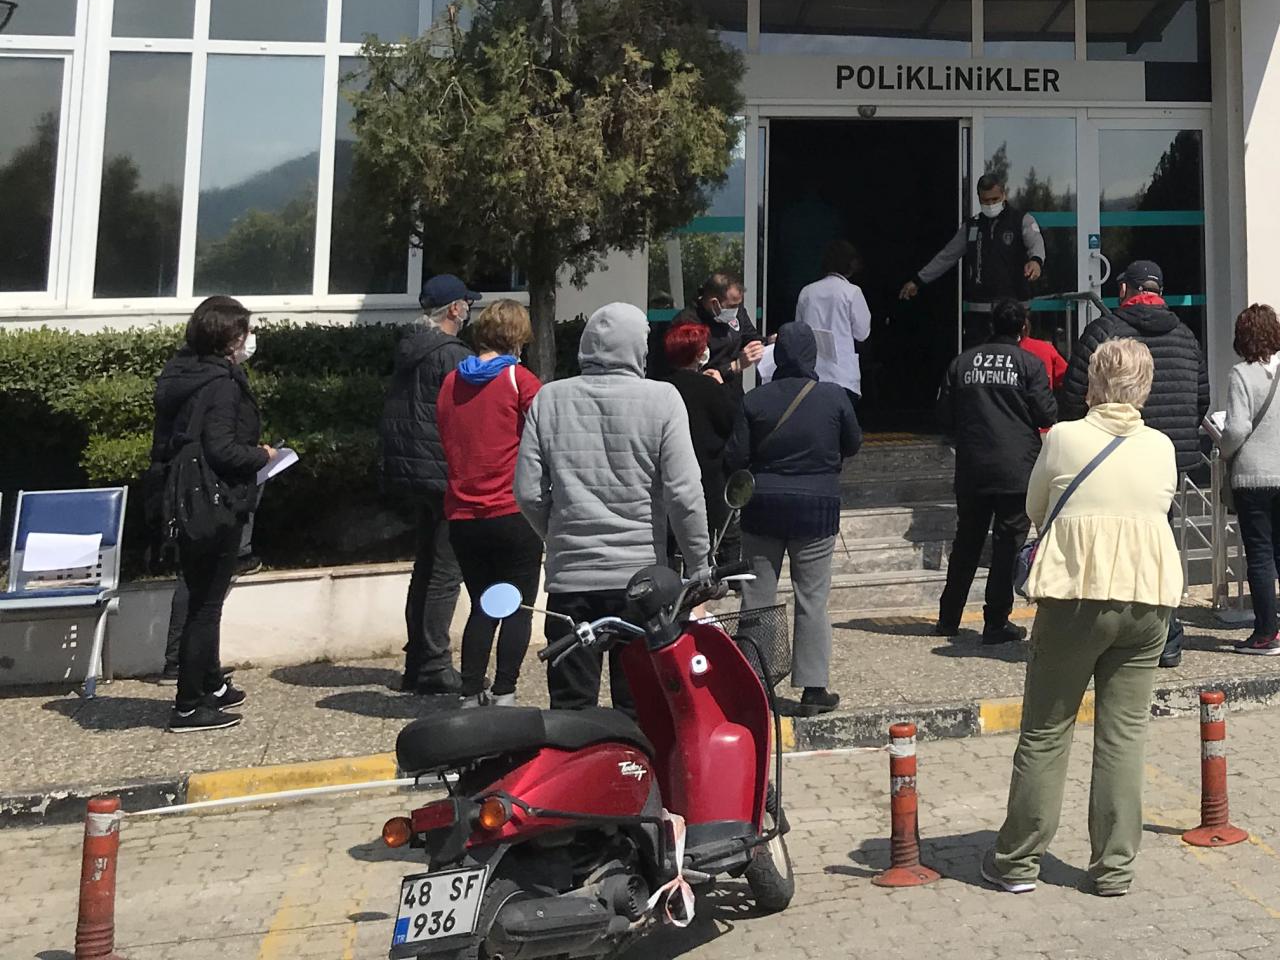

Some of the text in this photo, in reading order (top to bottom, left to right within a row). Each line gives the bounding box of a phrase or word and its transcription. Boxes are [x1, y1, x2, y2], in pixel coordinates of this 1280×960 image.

[973, 352, 1014, 368] ÖZEL
[964, 368, 1018, 386] GÜVENLİK
[404, 874, 480, 909] 48 SF
[413, 908, 456, 938] 936
